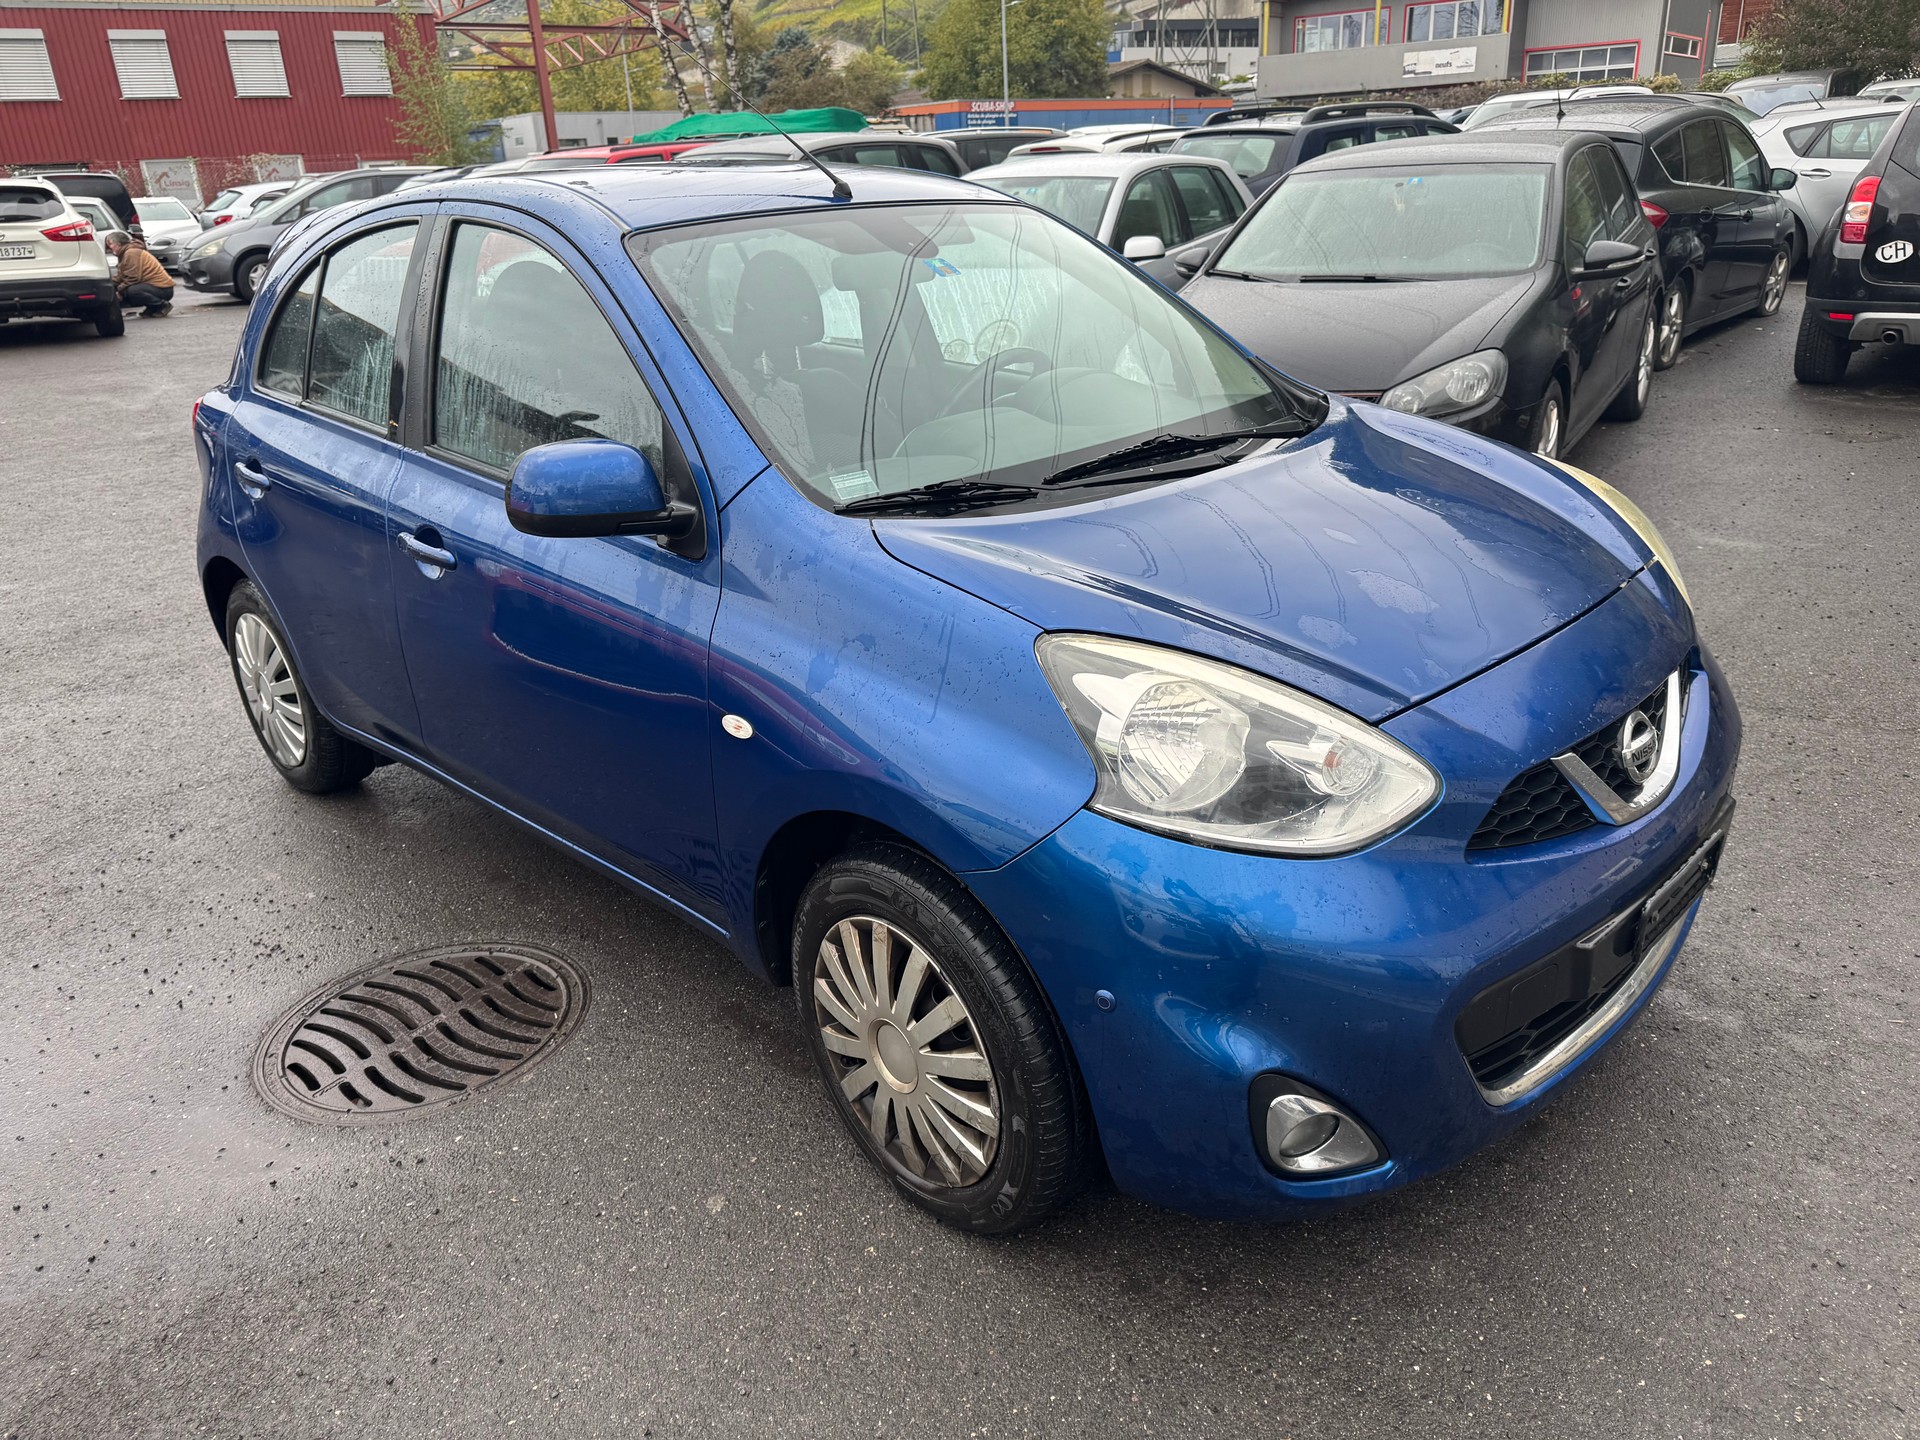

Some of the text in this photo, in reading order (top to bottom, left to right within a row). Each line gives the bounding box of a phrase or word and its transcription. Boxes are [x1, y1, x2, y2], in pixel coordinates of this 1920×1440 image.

[1435, 61, 1452, 69] neufs
[163, 180, 190, 188] Linsig
[0, 247, 26, 257] 18737
[1881, 242, 1906, 260] CH
[1631, 741, 1656, 763] NISS
